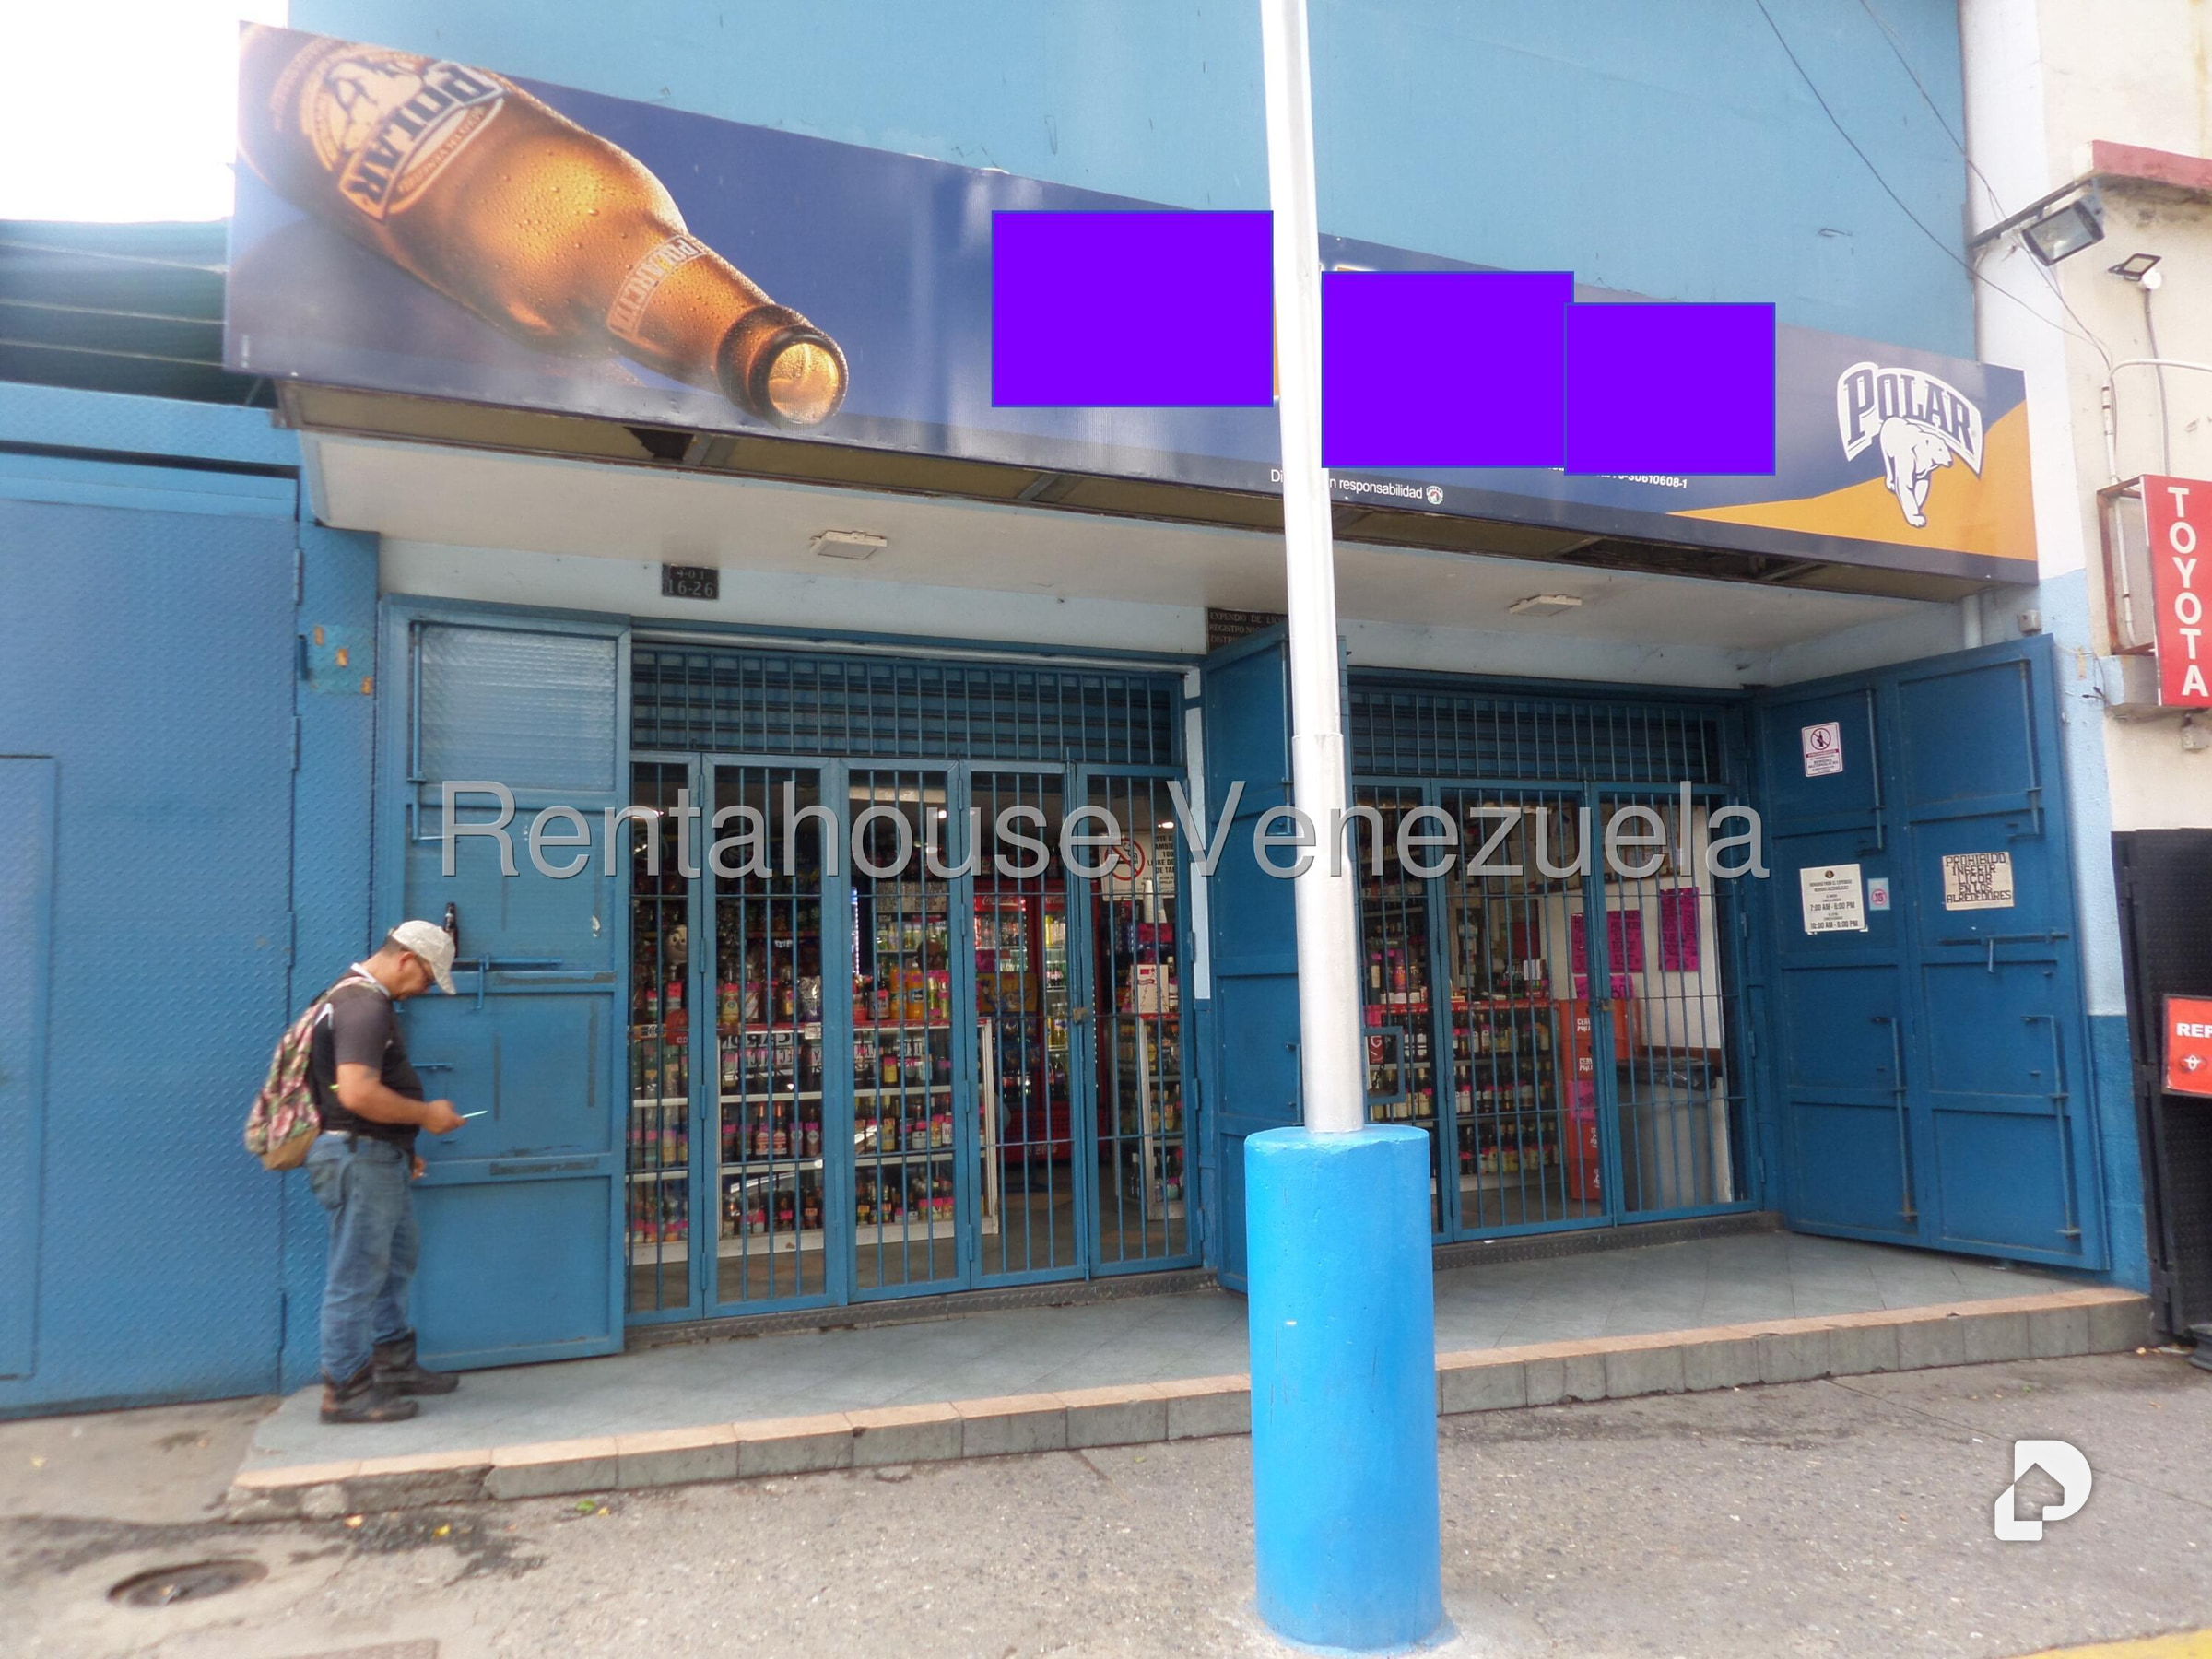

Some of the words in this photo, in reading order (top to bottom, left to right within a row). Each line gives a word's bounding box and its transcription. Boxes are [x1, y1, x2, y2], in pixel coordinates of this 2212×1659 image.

[348, 62, 502, 206] POLAR
[1843, 368, 1975, 455] POLAR
[1339, 477, 1422, 500] responsabilidad
[668, 579, 713, 597] 16-26
[2167, 486, 2209, 698] TOYOTA
[1209, 612, 1247, 622] EXPENDIO
[1251, 615, 1261, 623] DE
[1946, 853, 2006, 867] PROHIBIDO
[1959, 873, 1993, 885] LICOR
[1947, 890, 2011, 903] ALREDEDORES
[1959, 884, 1971, 893] EN
